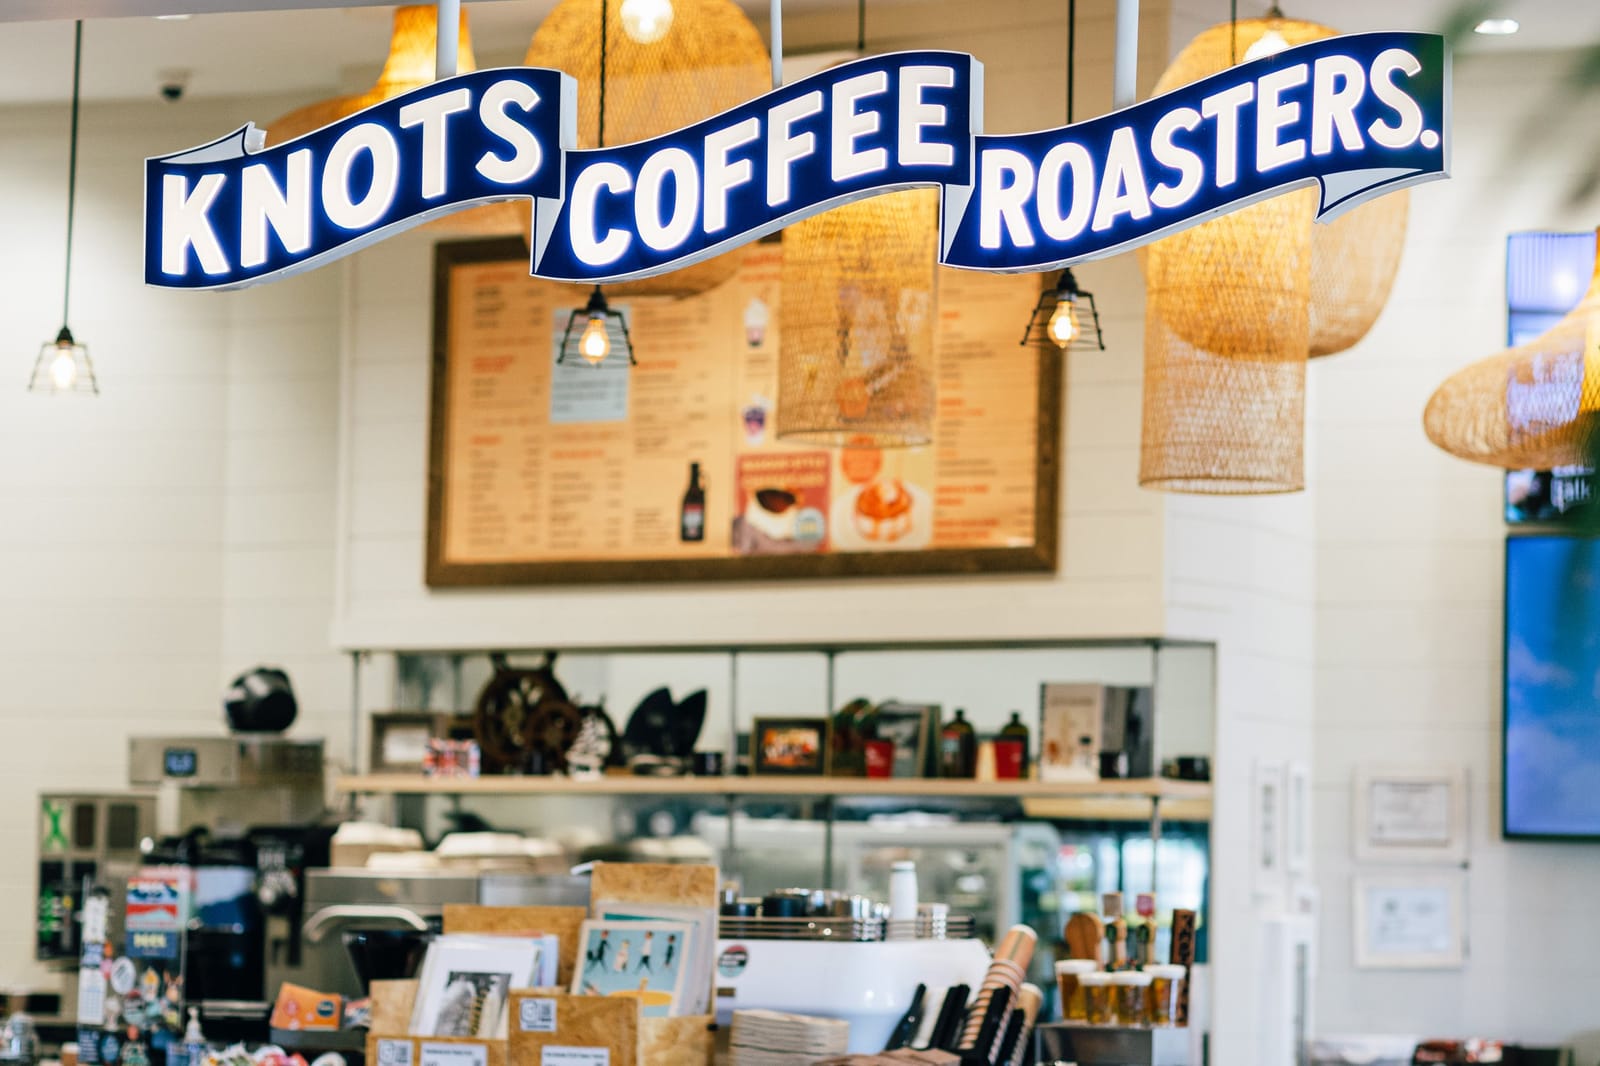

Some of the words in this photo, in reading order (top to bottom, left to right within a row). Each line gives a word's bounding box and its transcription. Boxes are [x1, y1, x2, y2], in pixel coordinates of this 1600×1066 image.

[161, 79, 542, 275] KNOTS
[569, 65, 954, 266] COFFEE
[979, 48, 1440, 249] ROASTERS.
